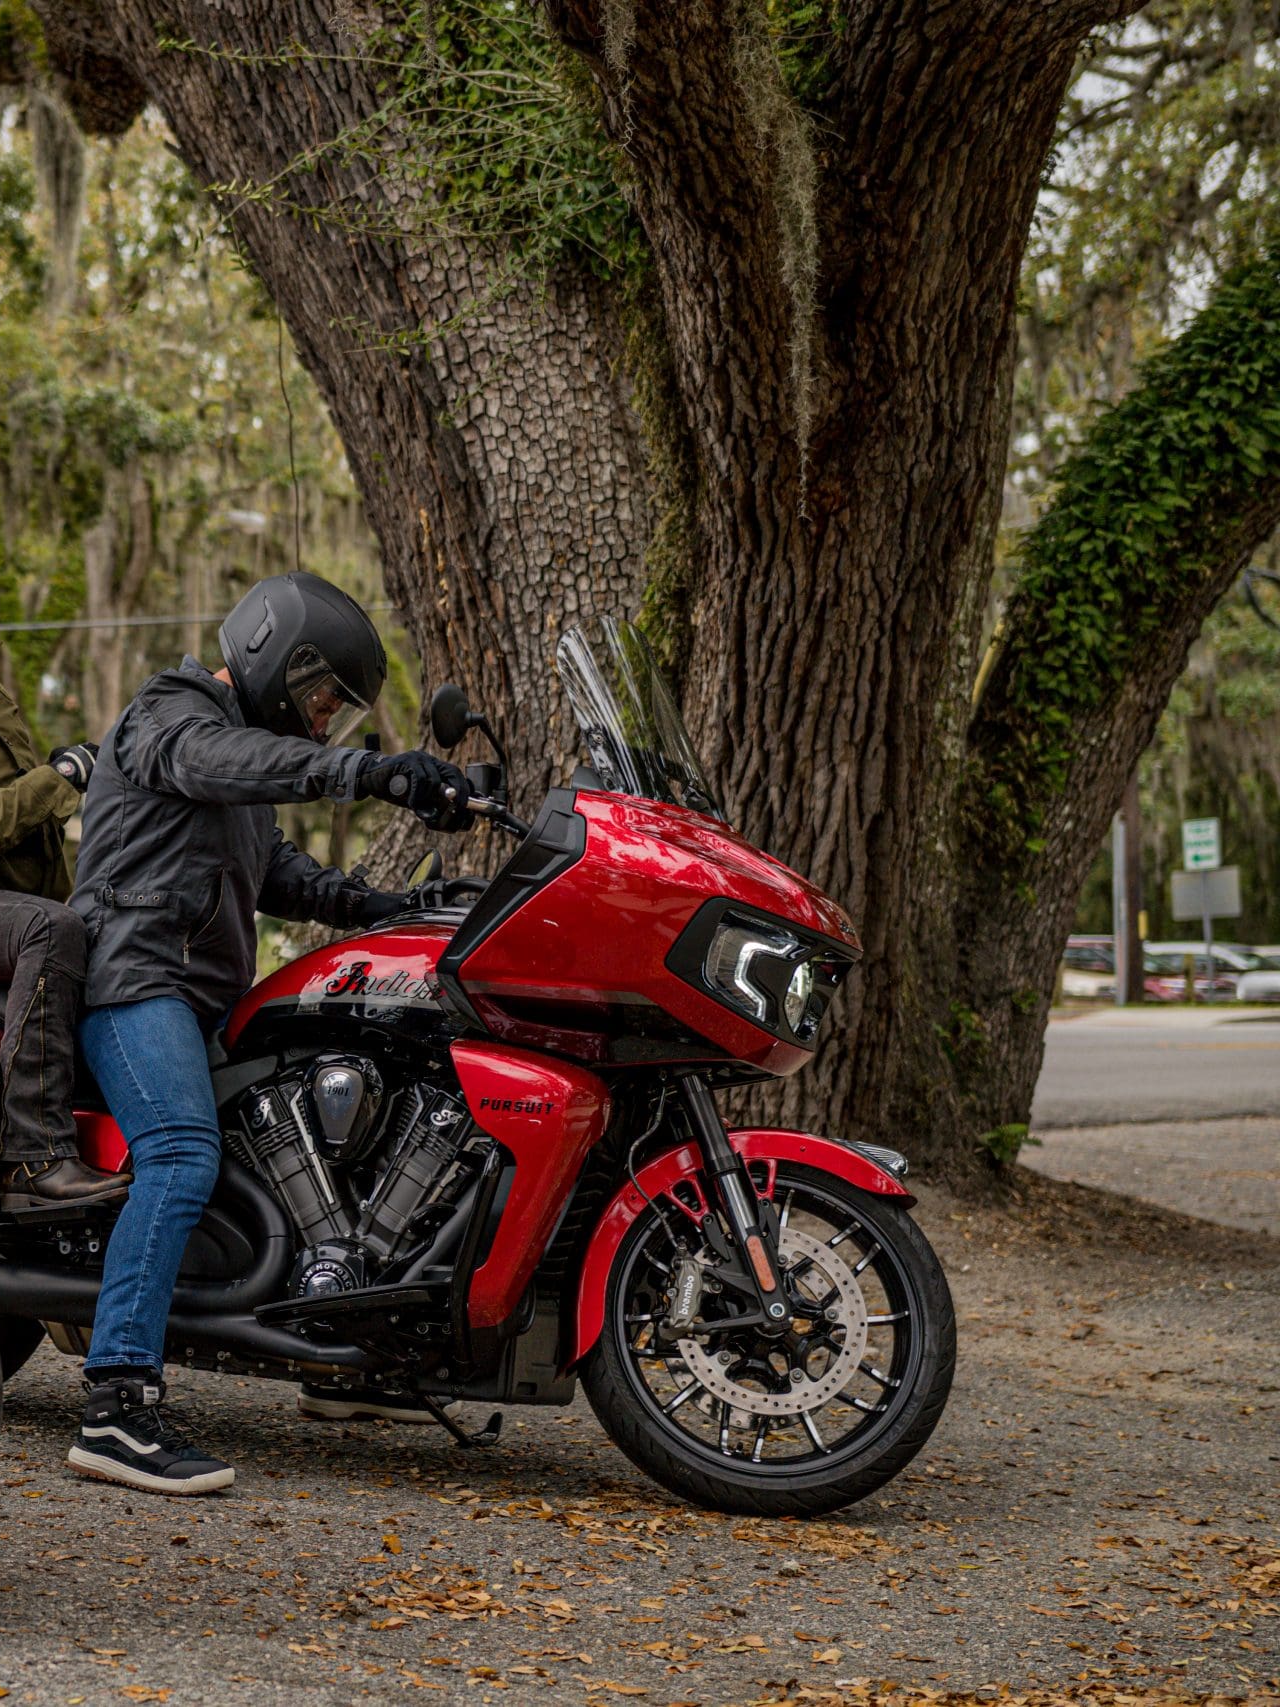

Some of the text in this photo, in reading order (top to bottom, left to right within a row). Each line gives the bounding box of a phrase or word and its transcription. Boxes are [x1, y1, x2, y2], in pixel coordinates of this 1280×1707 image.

[327, 1086, 350, 1097] 1901
[479, 1097, 554, 1115] PURSUIT
[315, 1262, 354, 1291] MOTORC
[678, 1275, 694, 1315] brembo
